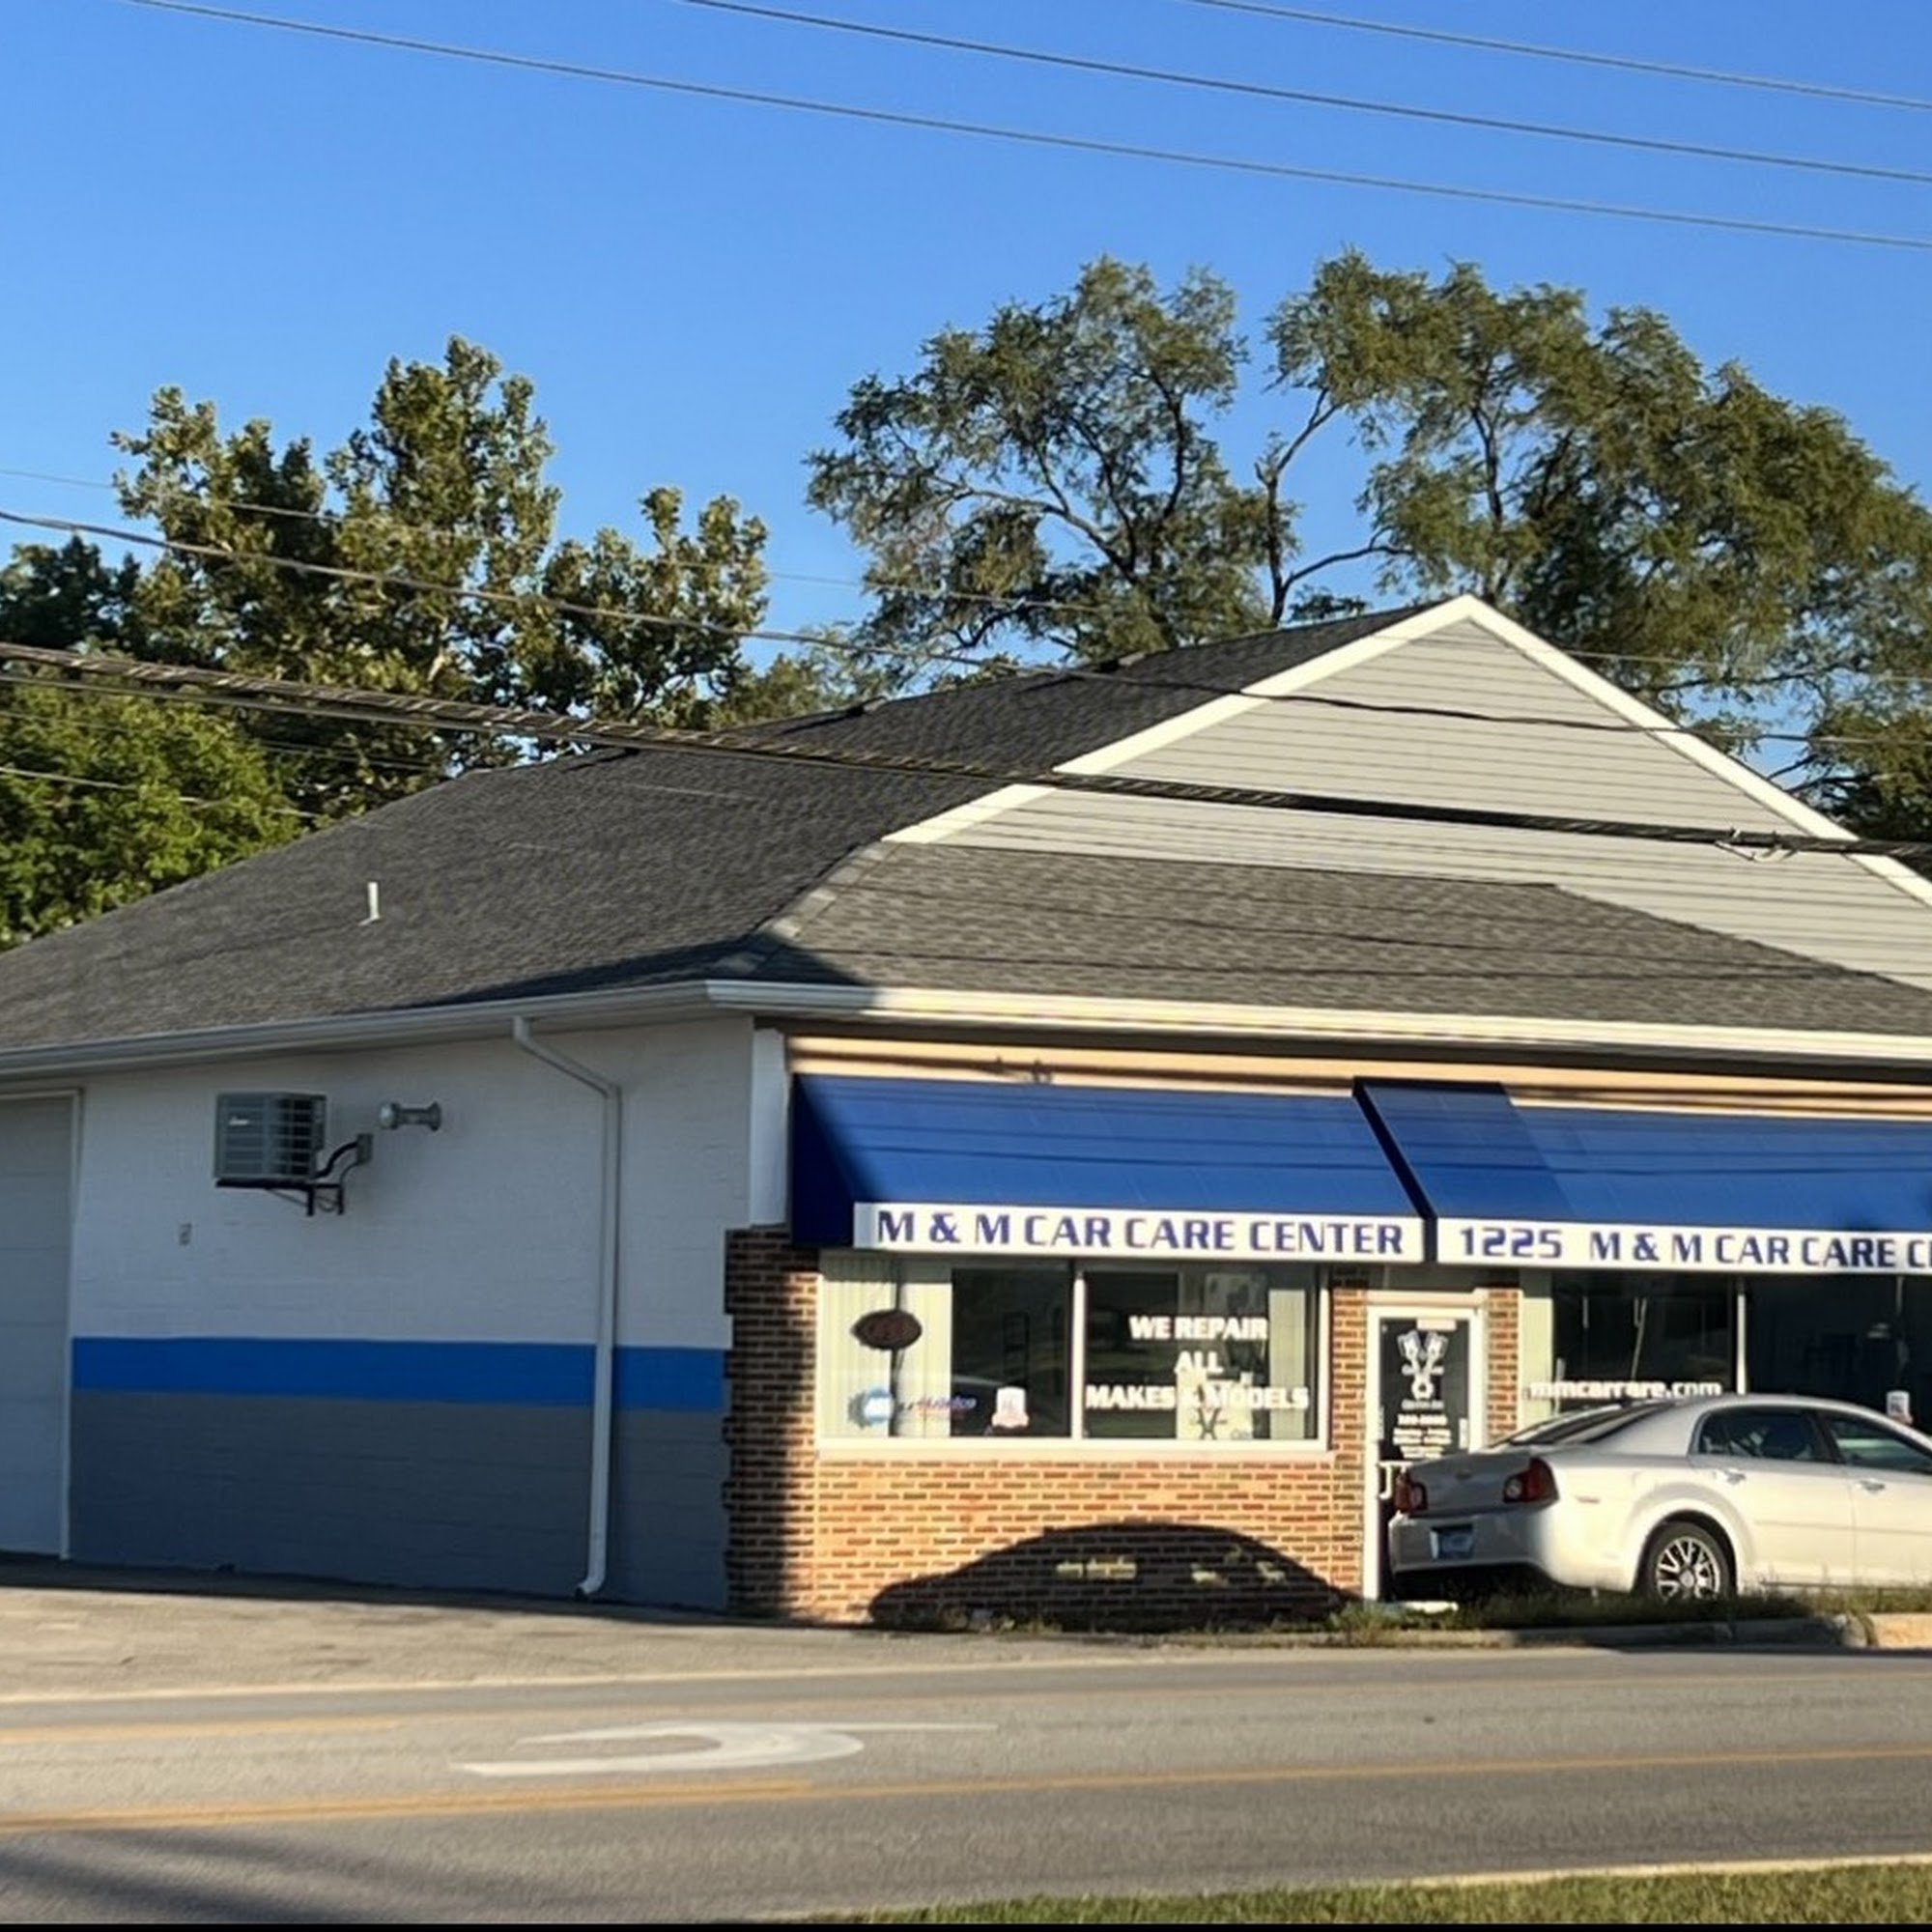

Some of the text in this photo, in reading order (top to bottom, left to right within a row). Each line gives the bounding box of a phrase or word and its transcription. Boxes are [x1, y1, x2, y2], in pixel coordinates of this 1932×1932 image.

[878, 1209, 1404, 1255] M & M CAR CARE CENTER
[1460, 1226, 1932, 1269] 1225 M & M CAR CARE C
[1129, 1316, 1268, 1341] WE REPAIR
[1174, 1350, 1224, 1374] ALL
[1085, 1383, 1176, 1409] MAKES
[1207, 1385, 1309, 1409] MODELS
